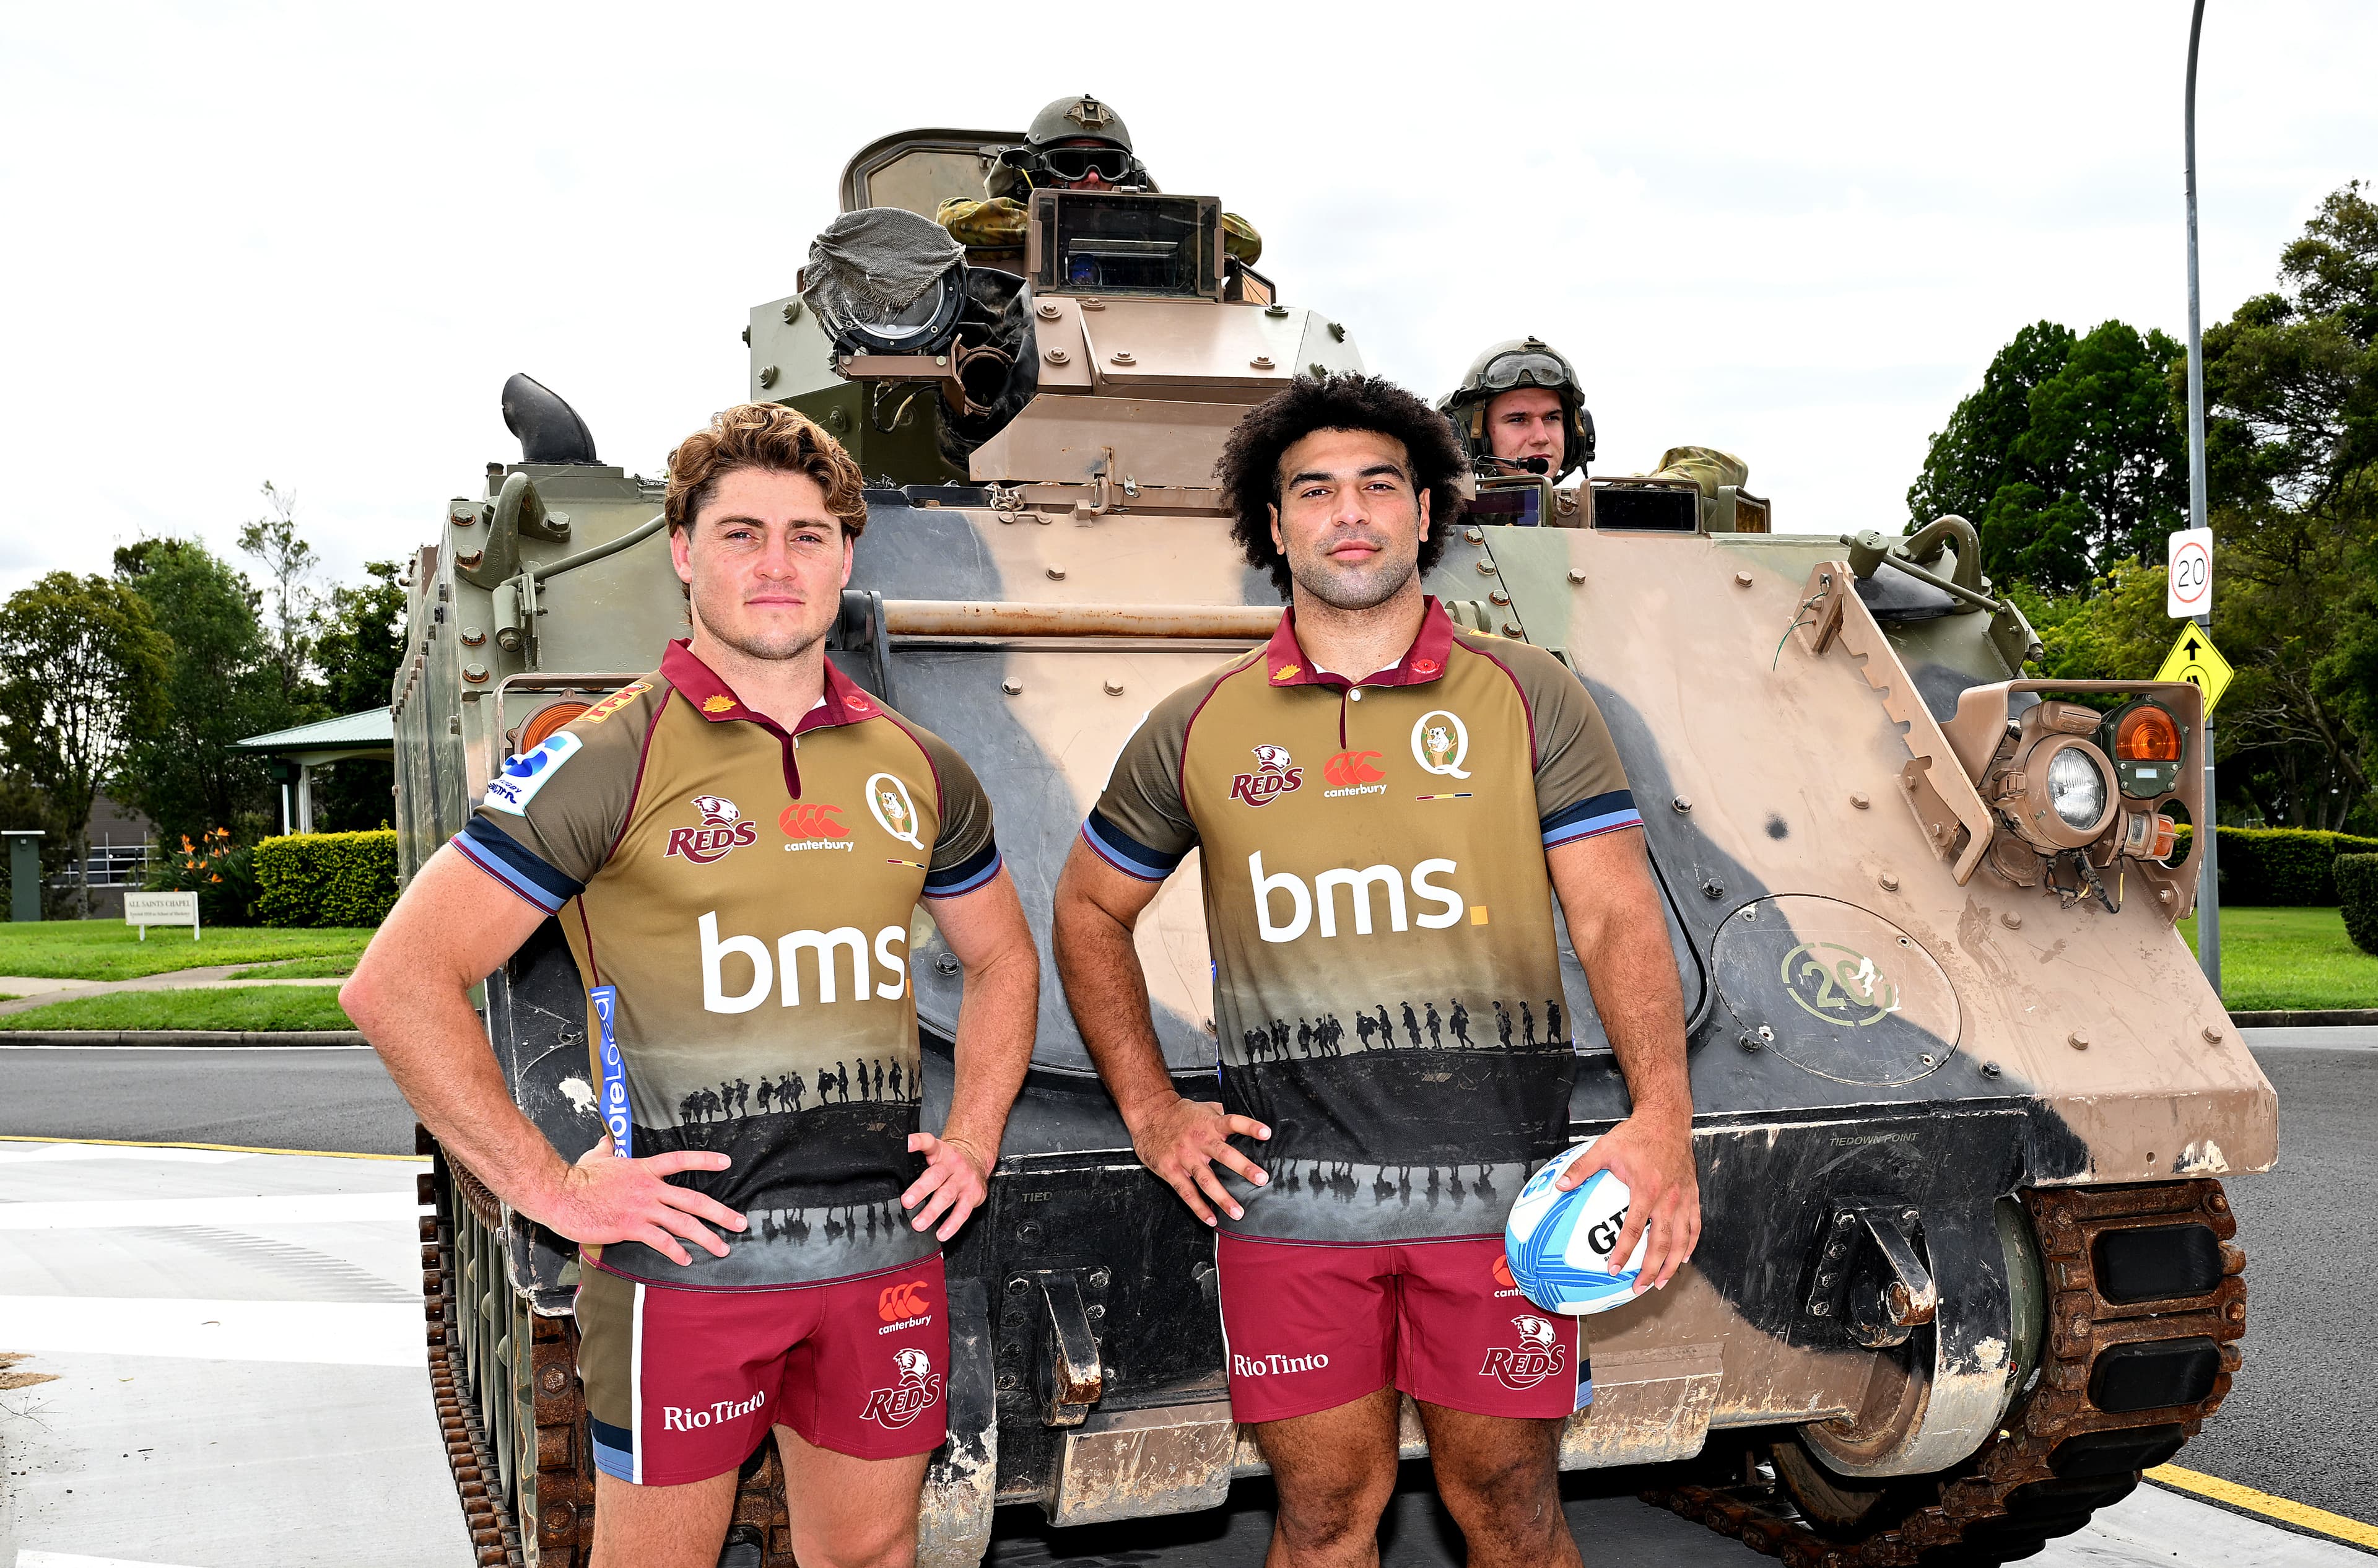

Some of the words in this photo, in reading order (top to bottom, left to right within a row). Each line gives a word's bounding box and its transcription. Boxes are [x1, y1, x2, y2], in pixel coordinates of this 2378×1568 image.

[2178, 558, 2205, 588] 20
[1411, 710, 1472, 780] Q
[1228, 767, 1304, 808] REDS
[1323, 784, 1387, 798] canterbury
[865, 772, 925, 851] Q
[663, 821, 758, 865] REDS
[784, 838, 854, 852] canterbury
[1248, 850, 1489, 943] bms.
[1830, 1135, 1881, 1146] TIEDOWN
[1884, 1133, 1919, 1143] POINT
[878, 1315, 931, 1335] canterbury
[1234, 1354, 1267, 1377] Rio
[1265, 1354, 1329, 1375] Tinto
[1478, 1344, 1566, 1390] REDS
[663, 1406, 711, 1432] Rio
[711, 1390, 765, 1424] Tinto
[859, 1374, 941, 1430] REDS
